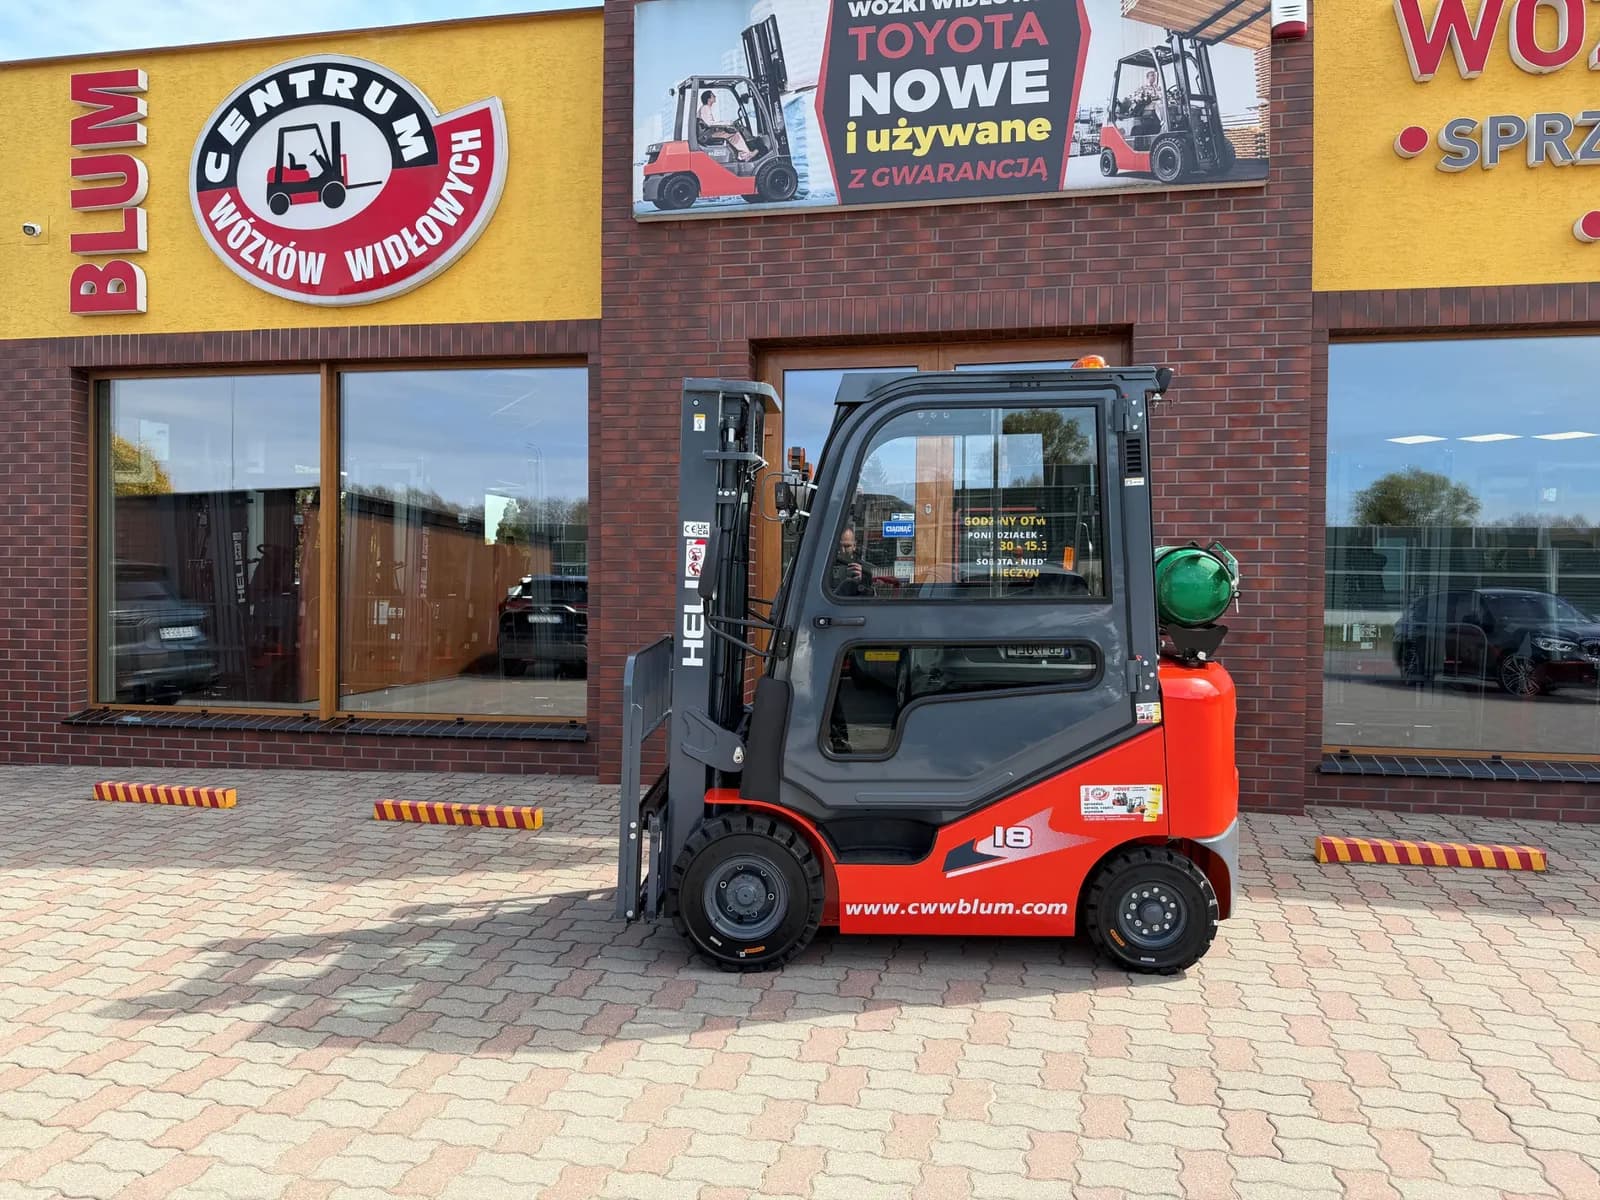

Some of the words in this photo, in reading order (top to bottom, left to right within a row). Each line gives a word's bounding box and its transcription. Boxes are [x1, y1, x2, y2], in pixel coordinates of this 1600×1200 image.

[848, 11, 1049, 61] TOYOTA
[849, 59, 1050, 117] NOWE
[205, 68, 429, 184] CENTRUM
[846, 121, 857, 154] i
[866, 117, 1052, 157] używane
[848, 169, 867, 189] Z
[871, 156, 1049, 188] GWARANCJĄ
[70, 69, 148, 315] BLUM
[209, 192, 326, 286] WÓZKÓW
[344, 128, 482, 283] WIDŁOWYCH
[964, 516, 1017, 526] GODZNY
[968, 531, 1037, 539] PONIDZIAŁEK
[1021, 558, 1048, 566] NIED
[992, 825, 1033, 848] 18
[845, 898, 1068, 915] www.cwwblum.com
